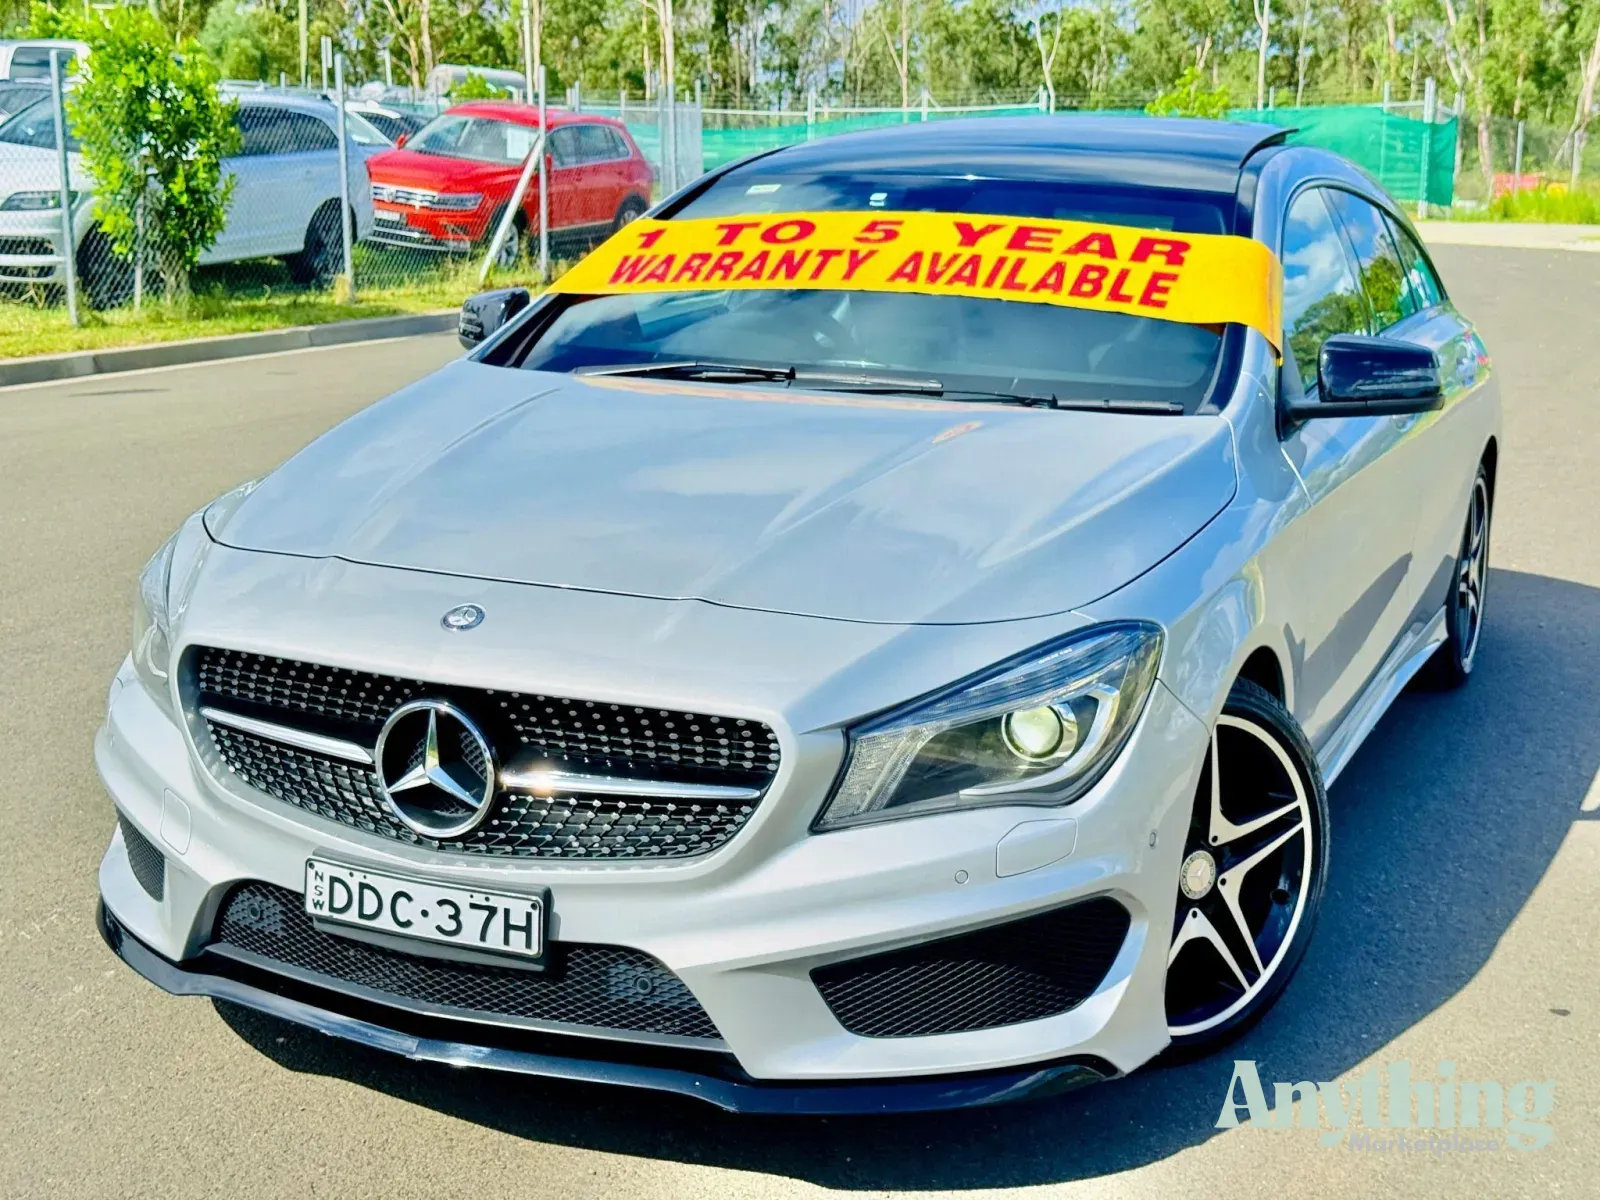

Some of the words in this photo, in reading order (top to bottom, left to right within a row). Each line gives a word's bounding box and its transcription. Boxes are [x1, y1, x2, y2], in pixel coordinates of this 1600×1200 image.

[637, 228, 666, 249] 1
[716, 220, 815, 246] TO
[853, 220, 902, 244] 5
[954, 222, 1192, 267] YEAR
[609, 249, 877, 284] WARRANTY
[888, 251, 1180, 309] AVAILABLE
[312, 870, 325, 911] NSW
